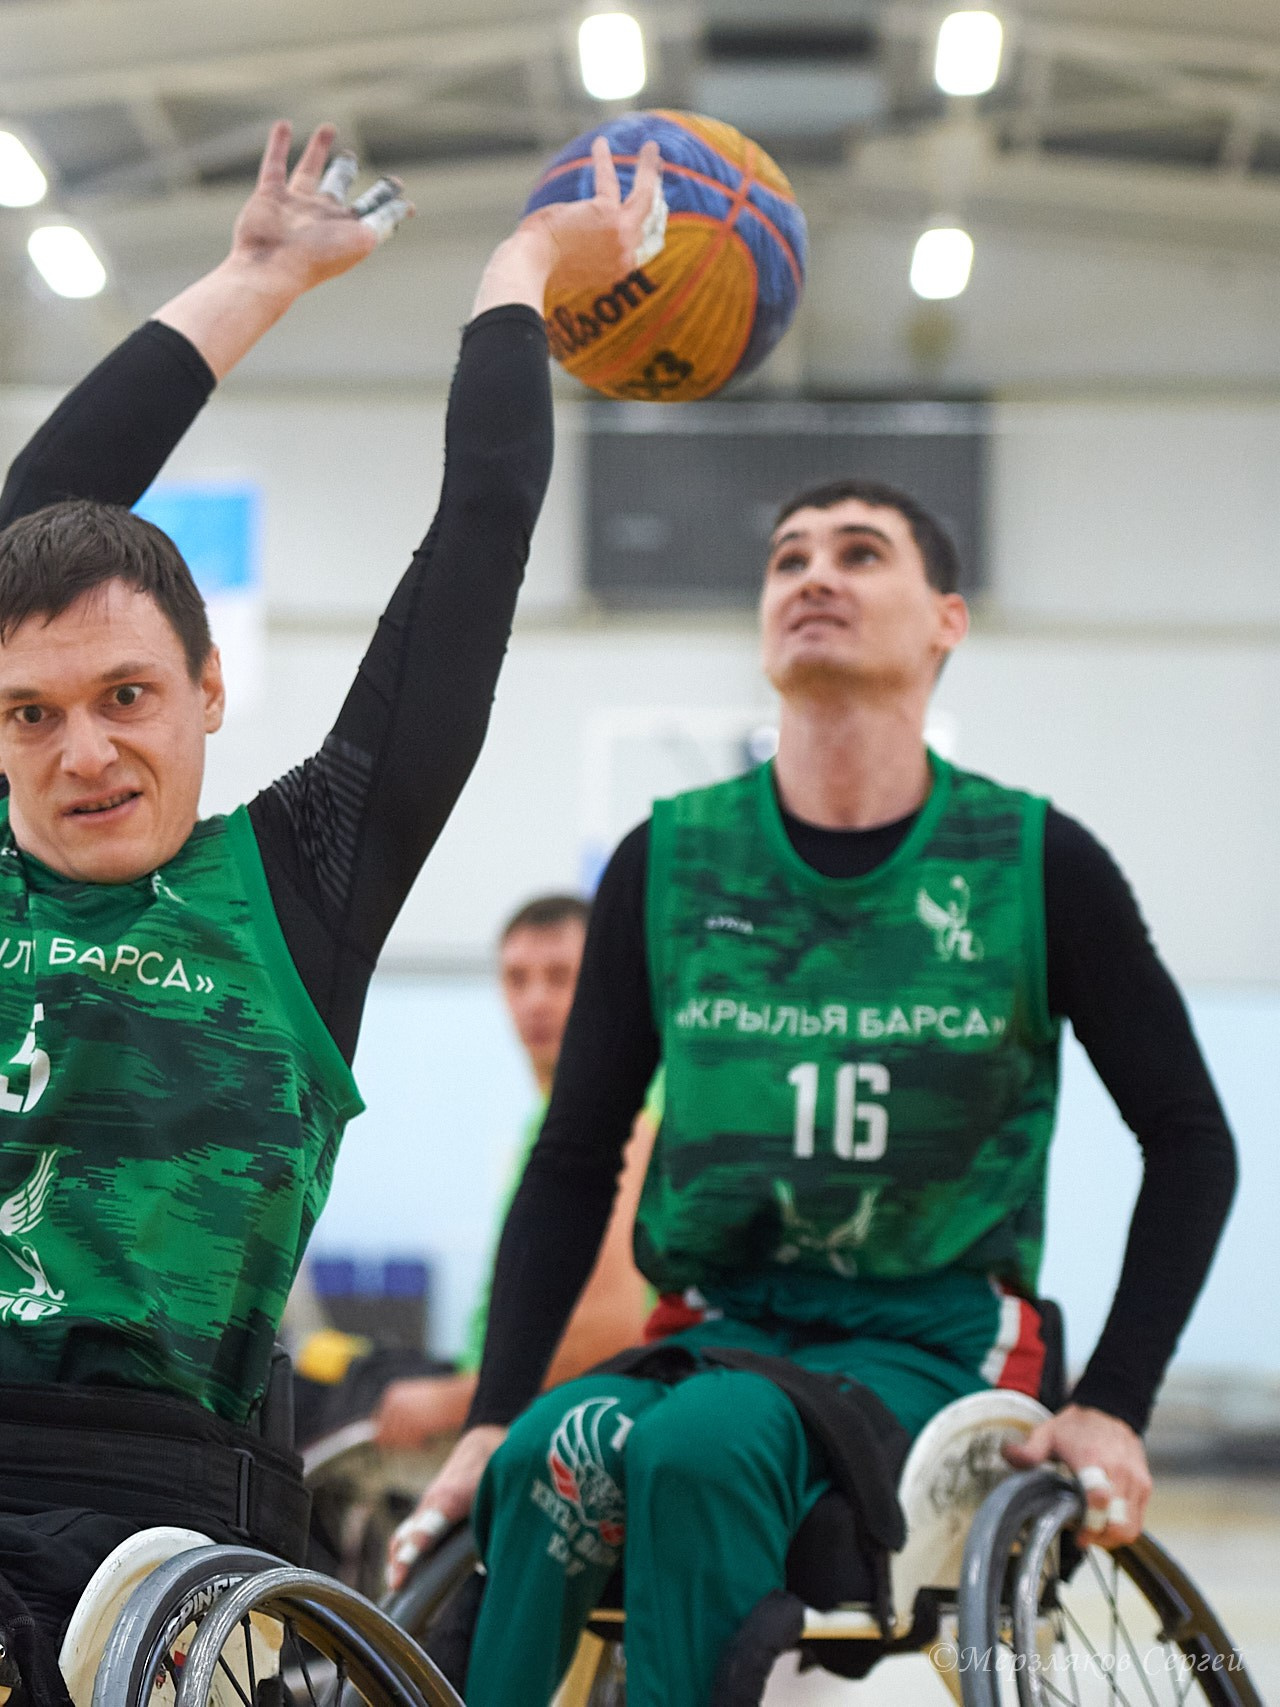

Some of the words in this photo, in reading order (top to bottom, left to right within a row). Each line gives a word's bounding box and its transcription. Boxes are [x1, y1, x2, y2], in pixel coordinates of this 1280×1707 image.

[49, 937, 215, 994] БАРСА»
[675, 998, 849, 1037] «КРЫЛЬЯ
[858, 1003, 1008, 1039] БАРСА»
[787, 1061, 892, 1163] 16
